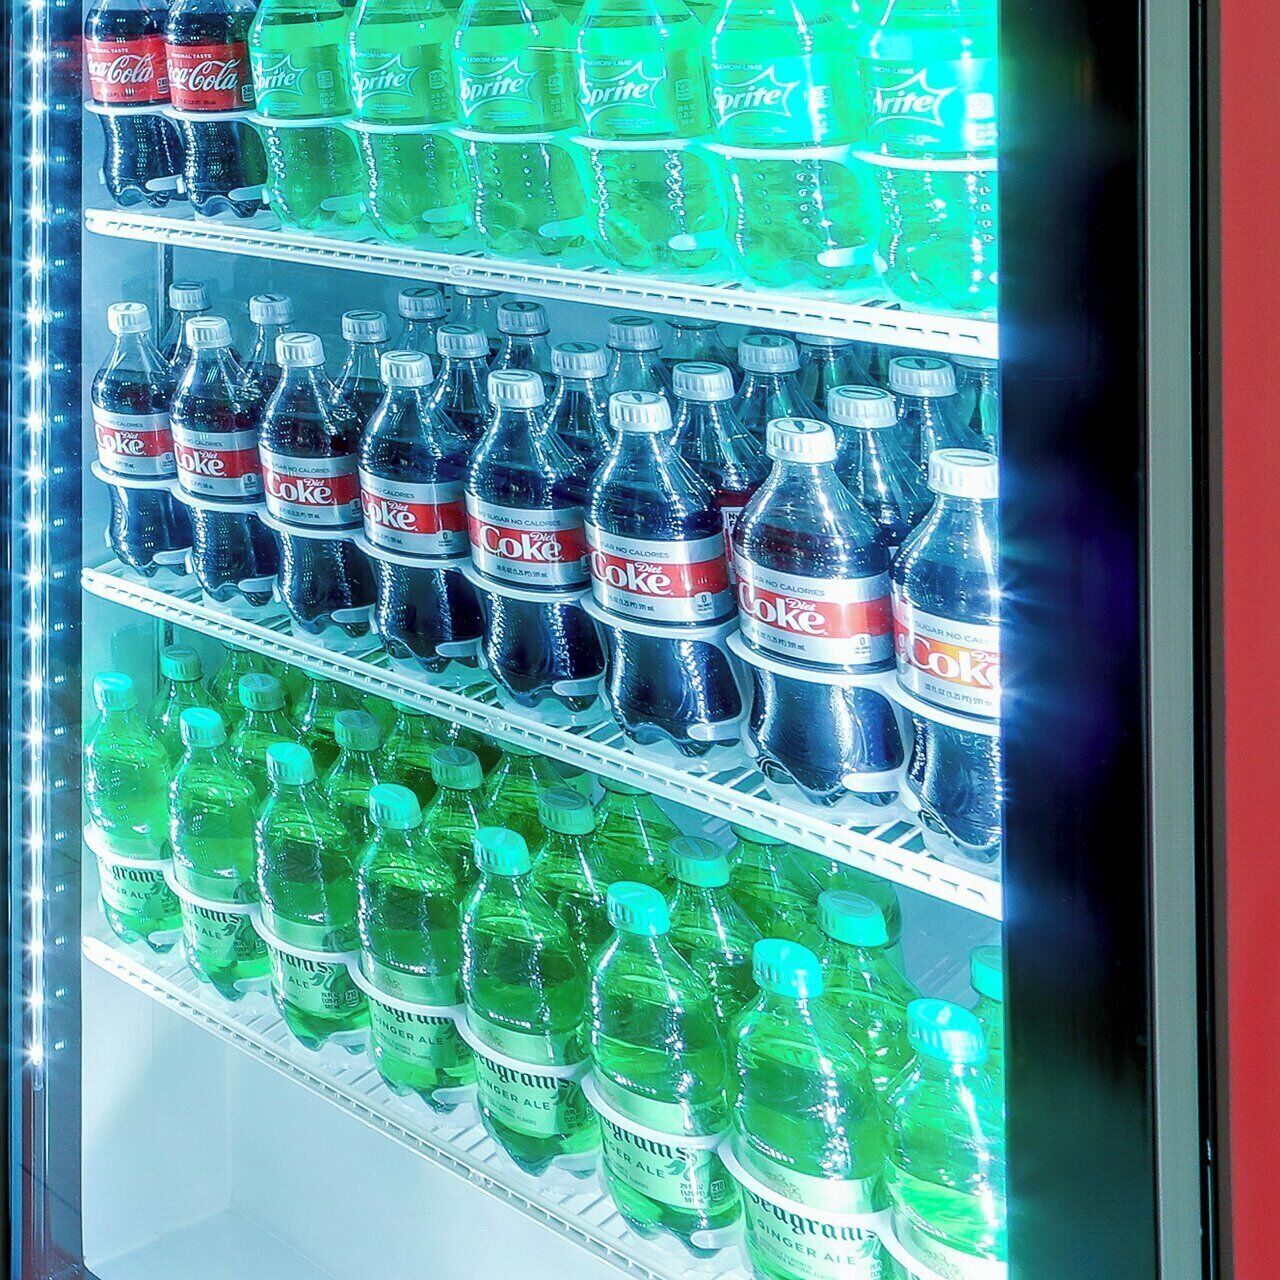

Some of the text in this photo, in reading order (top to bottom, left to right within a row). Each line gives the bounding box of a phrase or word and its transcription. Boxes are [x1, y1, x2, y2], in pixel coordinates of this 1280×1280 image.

[253, 66, 296, 90] Sprite
[352, 67, 407, 92] Sprite
[461, 74, 526, 102] Sprite
[580, 79, 649, 105] Sprite
[713, 84, 782, 116] Sprite
[94, 422, 147, 456] Coke
[174, 441, 226, 477] Coke
[266, 472, 332, 504] Coke
[304, 478, 325, 487] Diet
[361, 488, 417, 532] Coke
[387, 500, 409, 511] Diet
[480, 525, 562, 561] Coke
[529, 532, 557, 542] Diet
[615, 545, 627, 554] NO
[590, 550, 672, 596] Coke
[635, 561, 663, 574] Diet
[765, 578, 778, 588] NO
[738, 581, 826, 635] Coke
[786, 597, 818, 611] Diet
[201, 928, 223, 940] ALE
[288, 976, 310, 990] ALE
[418, 1034, 444, 1046] ALE
[524, 1098, 551, 1111] ALE
[636, 1160, 666, 1179] ALE
[757, 1218, 857, 1266] GINGER ALE
